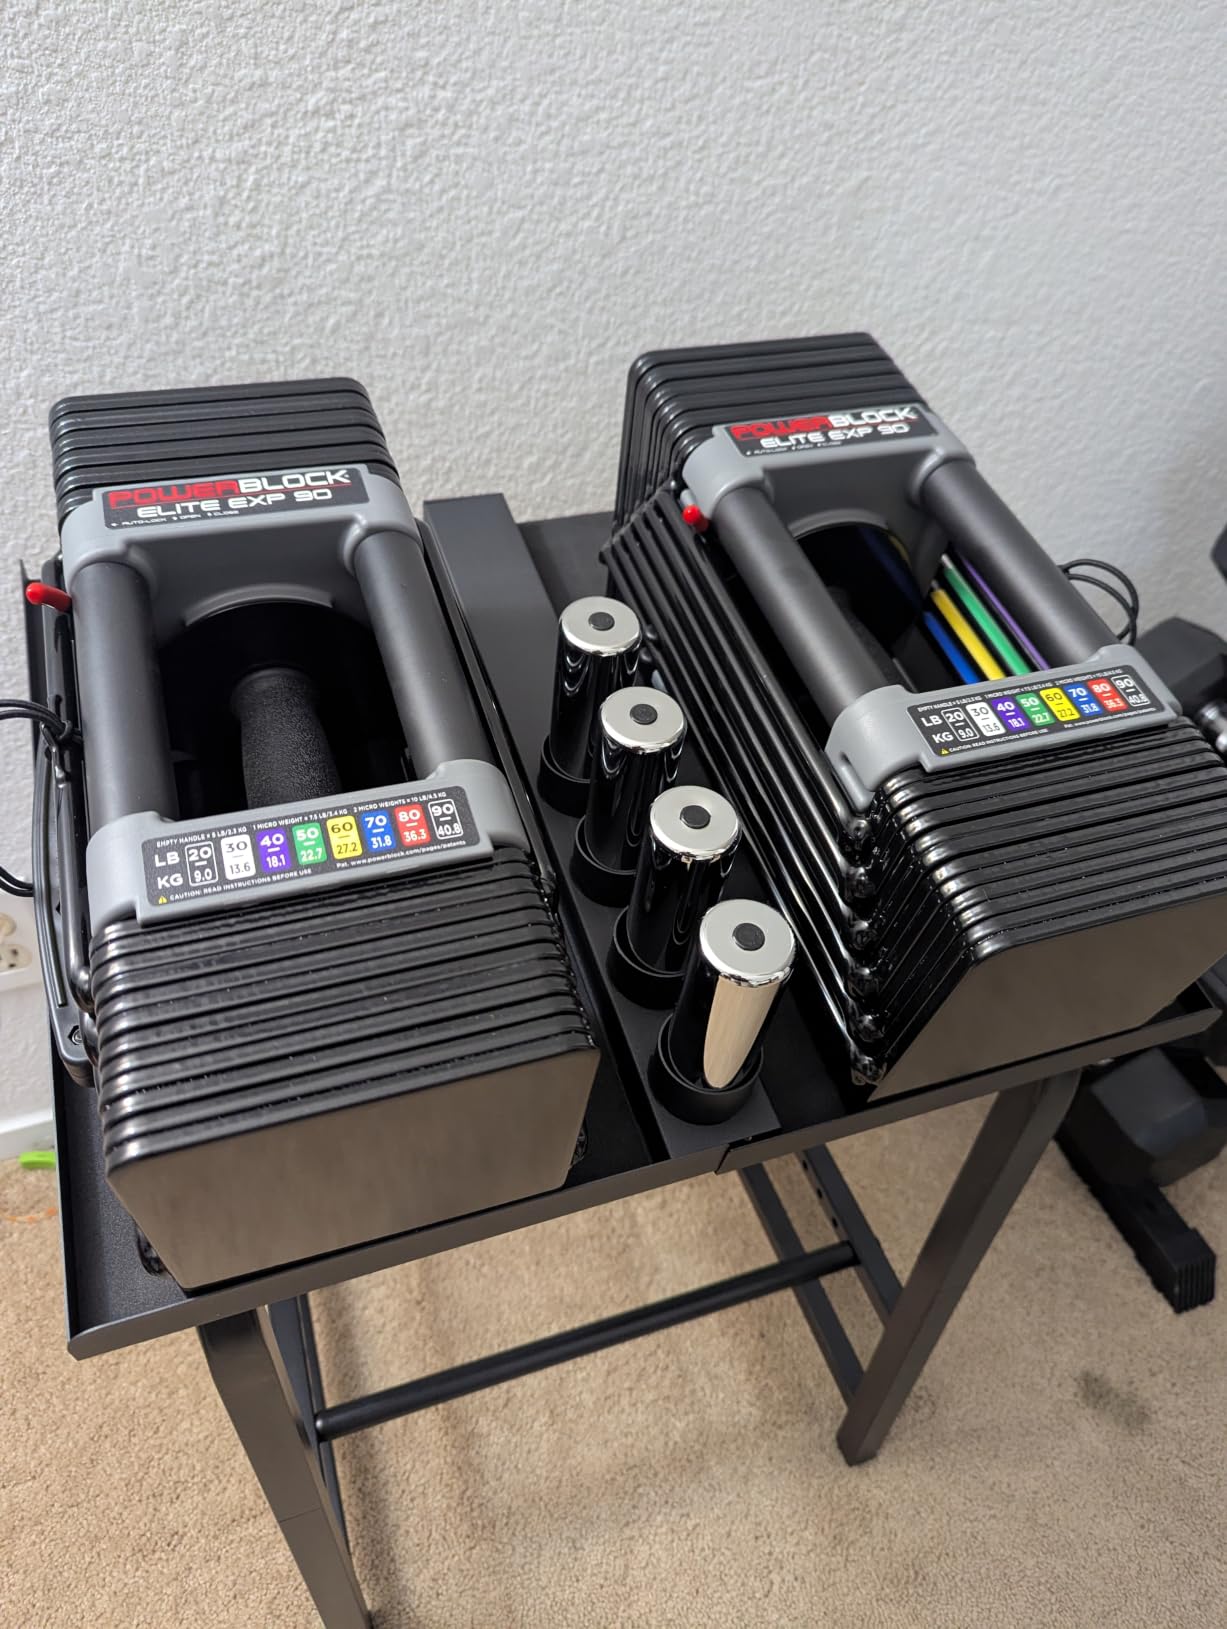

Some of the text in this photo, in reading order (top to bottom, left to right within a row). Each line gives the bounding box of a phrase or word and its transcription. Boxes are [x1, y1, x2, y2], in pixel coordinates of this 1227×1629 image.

[731, 408, 918, 440] POWERBLOCK
[760, 431, 825, 448] ELITE
[828, 426, 873, 440] EXP
[878, 423, 910, 434] 90
[108, 470, 351, 509] POWERBLOCK
[137, 489, 332, 518] ELITE EXP 90
[920, 679, 1134, 726] LB 20 30 40 50 60 70 80 90
[932, 732, 954, 743] KG
[958, 728, 974, 738] 9.0
[358, 803, 378, 812] MICRO
[379, 799, 406, 808] WEIGHTS
[278, 817, 302, 825] WEIGHT
[155, 804, 454, 867] LB 20 30 40 50 60 70 80 90
[157, 839, 177, 848] EMPTY
[179, 834, 205, 843] HANDLE
[157, 823, 460, 889] KG 9.0 13.6 18.1 22.7 27.2 31.8 36.3 40.8
[351, 840, 466, 866] www.powerblock.com/pages/patents
[223, 877, 270, 891] INSTRUCTIONS
[272, 872, 298, 881] BEFORE
